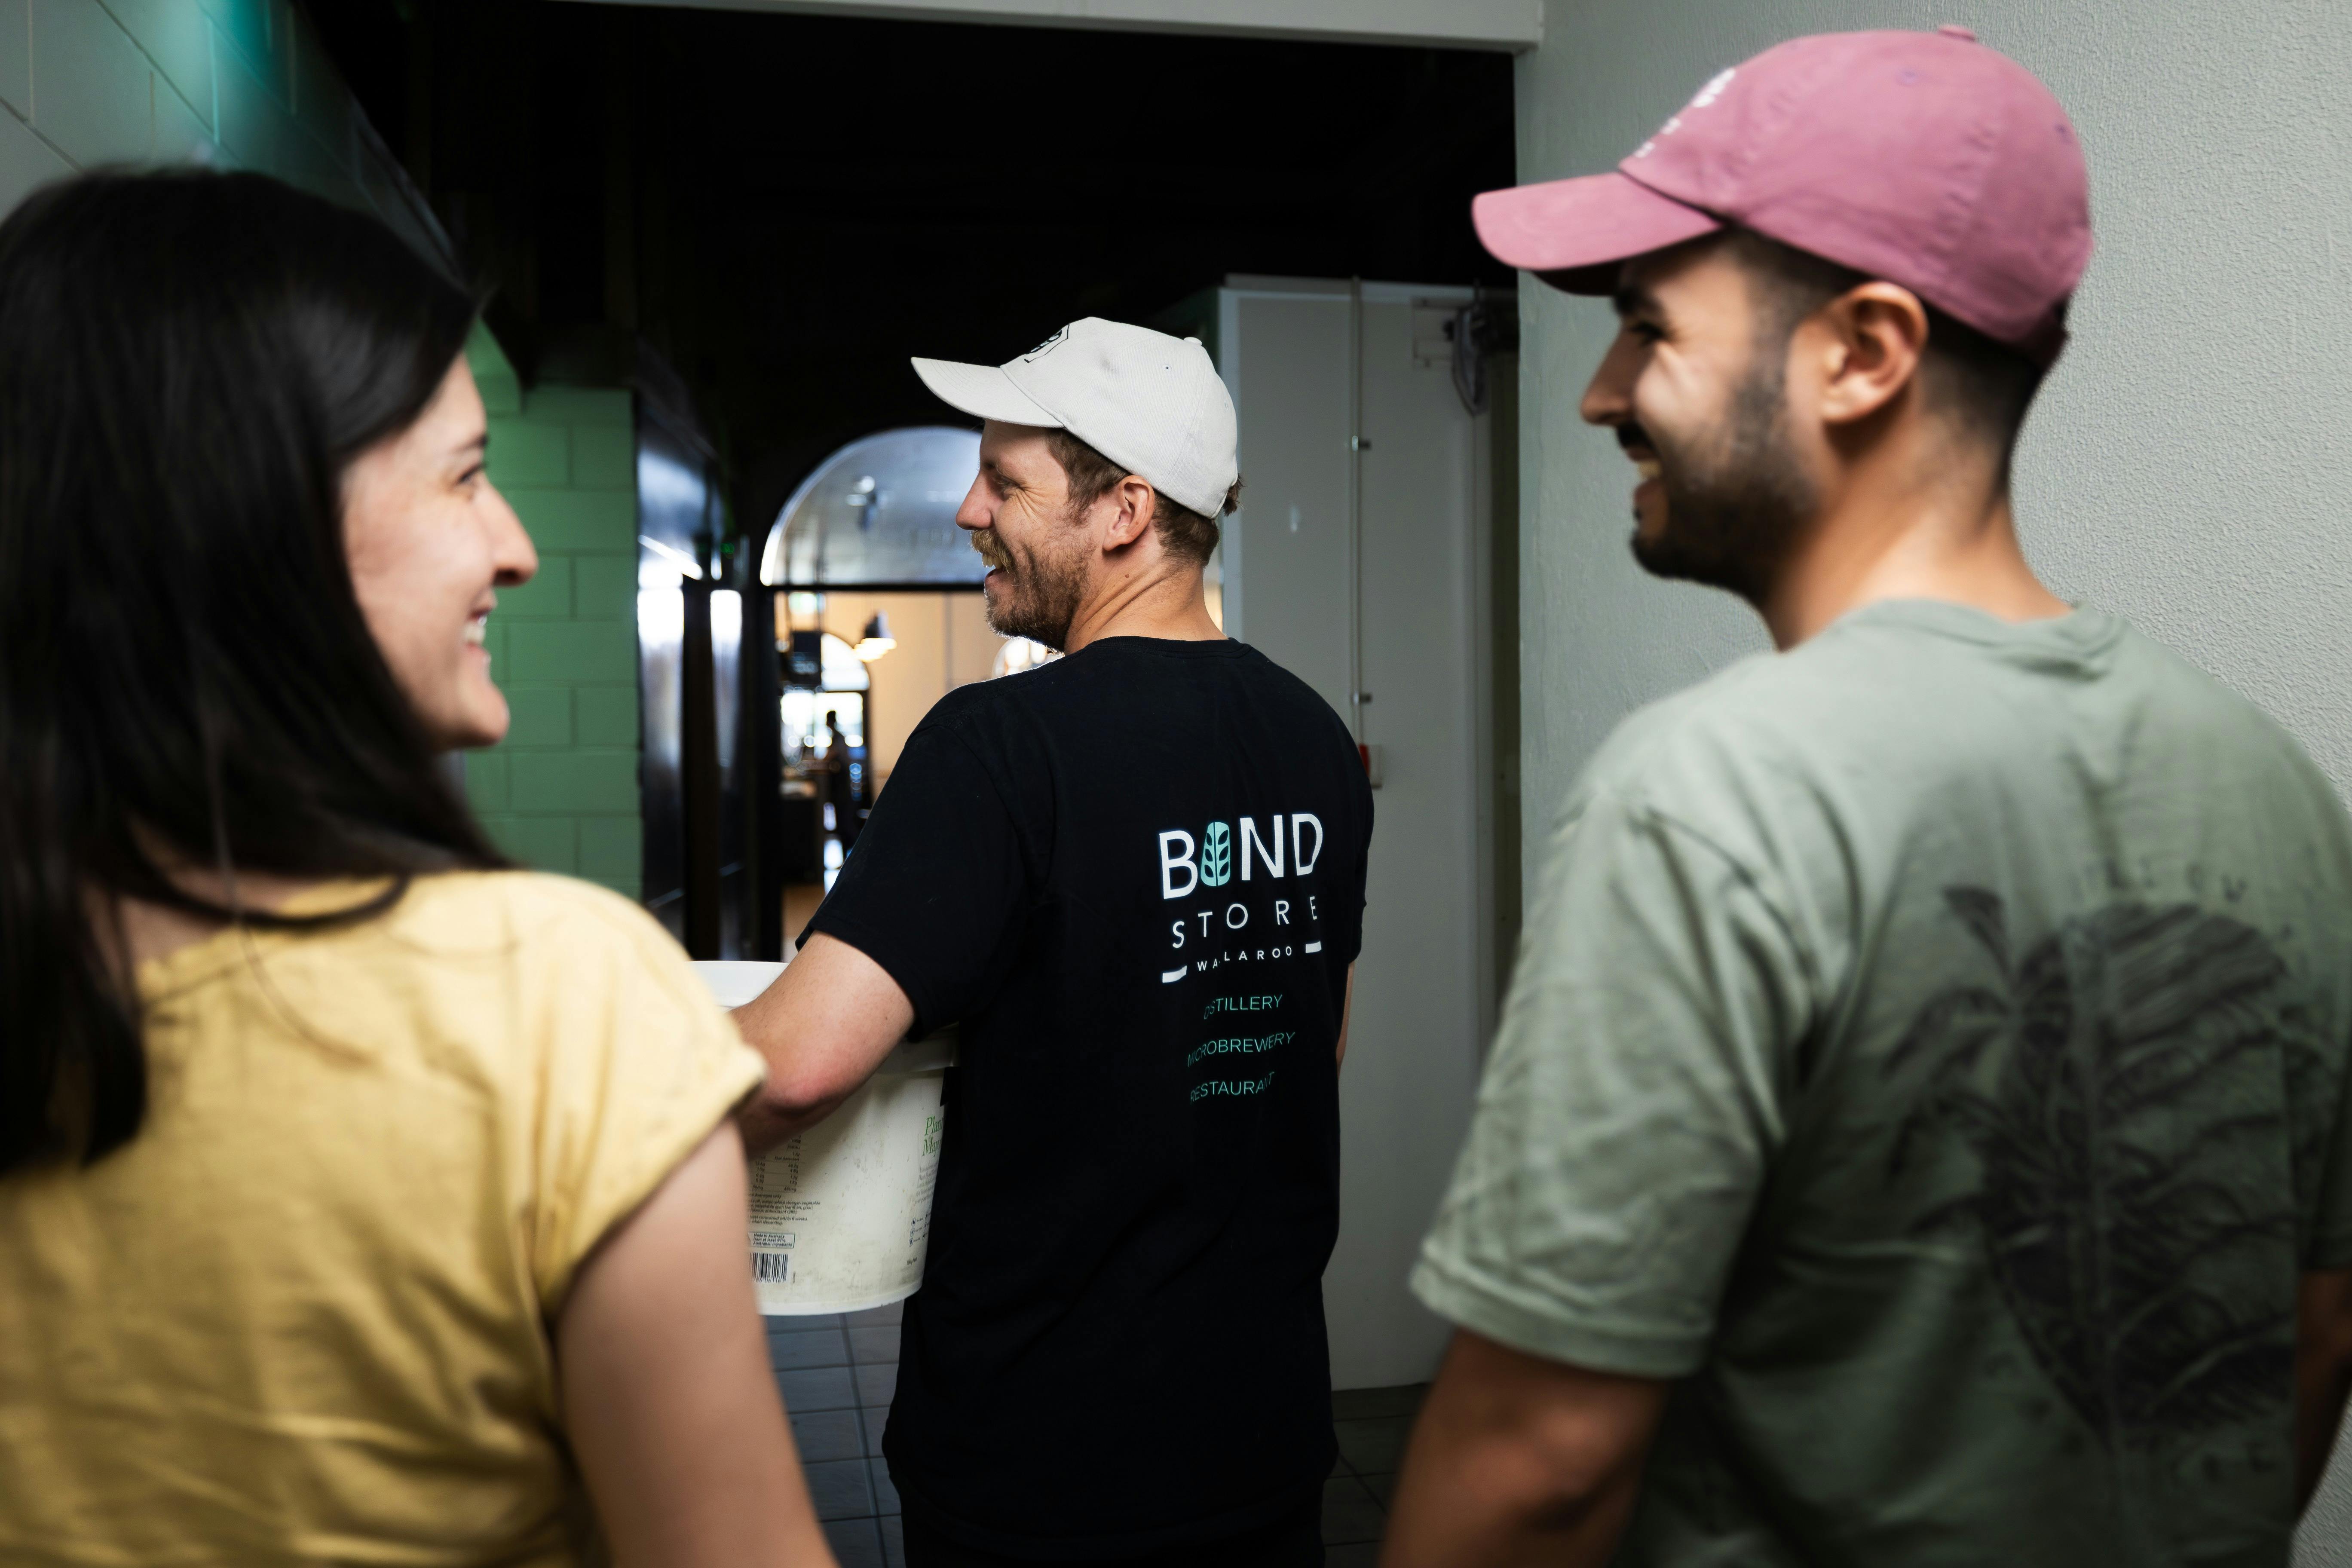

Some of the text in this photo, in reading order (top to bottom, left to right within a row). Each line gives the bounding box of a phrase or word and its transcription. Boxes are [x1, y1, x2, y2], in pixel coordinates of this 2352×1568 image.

[1159, 812, 1323, 899] BOND
[1173, 896, 1317, 948] STORE
[1197, 946, 1292, 972] WALAROO
[1204, 994, 1283, 1020] DSTILLERY
[925, 1115, 943, 1136] Plan
